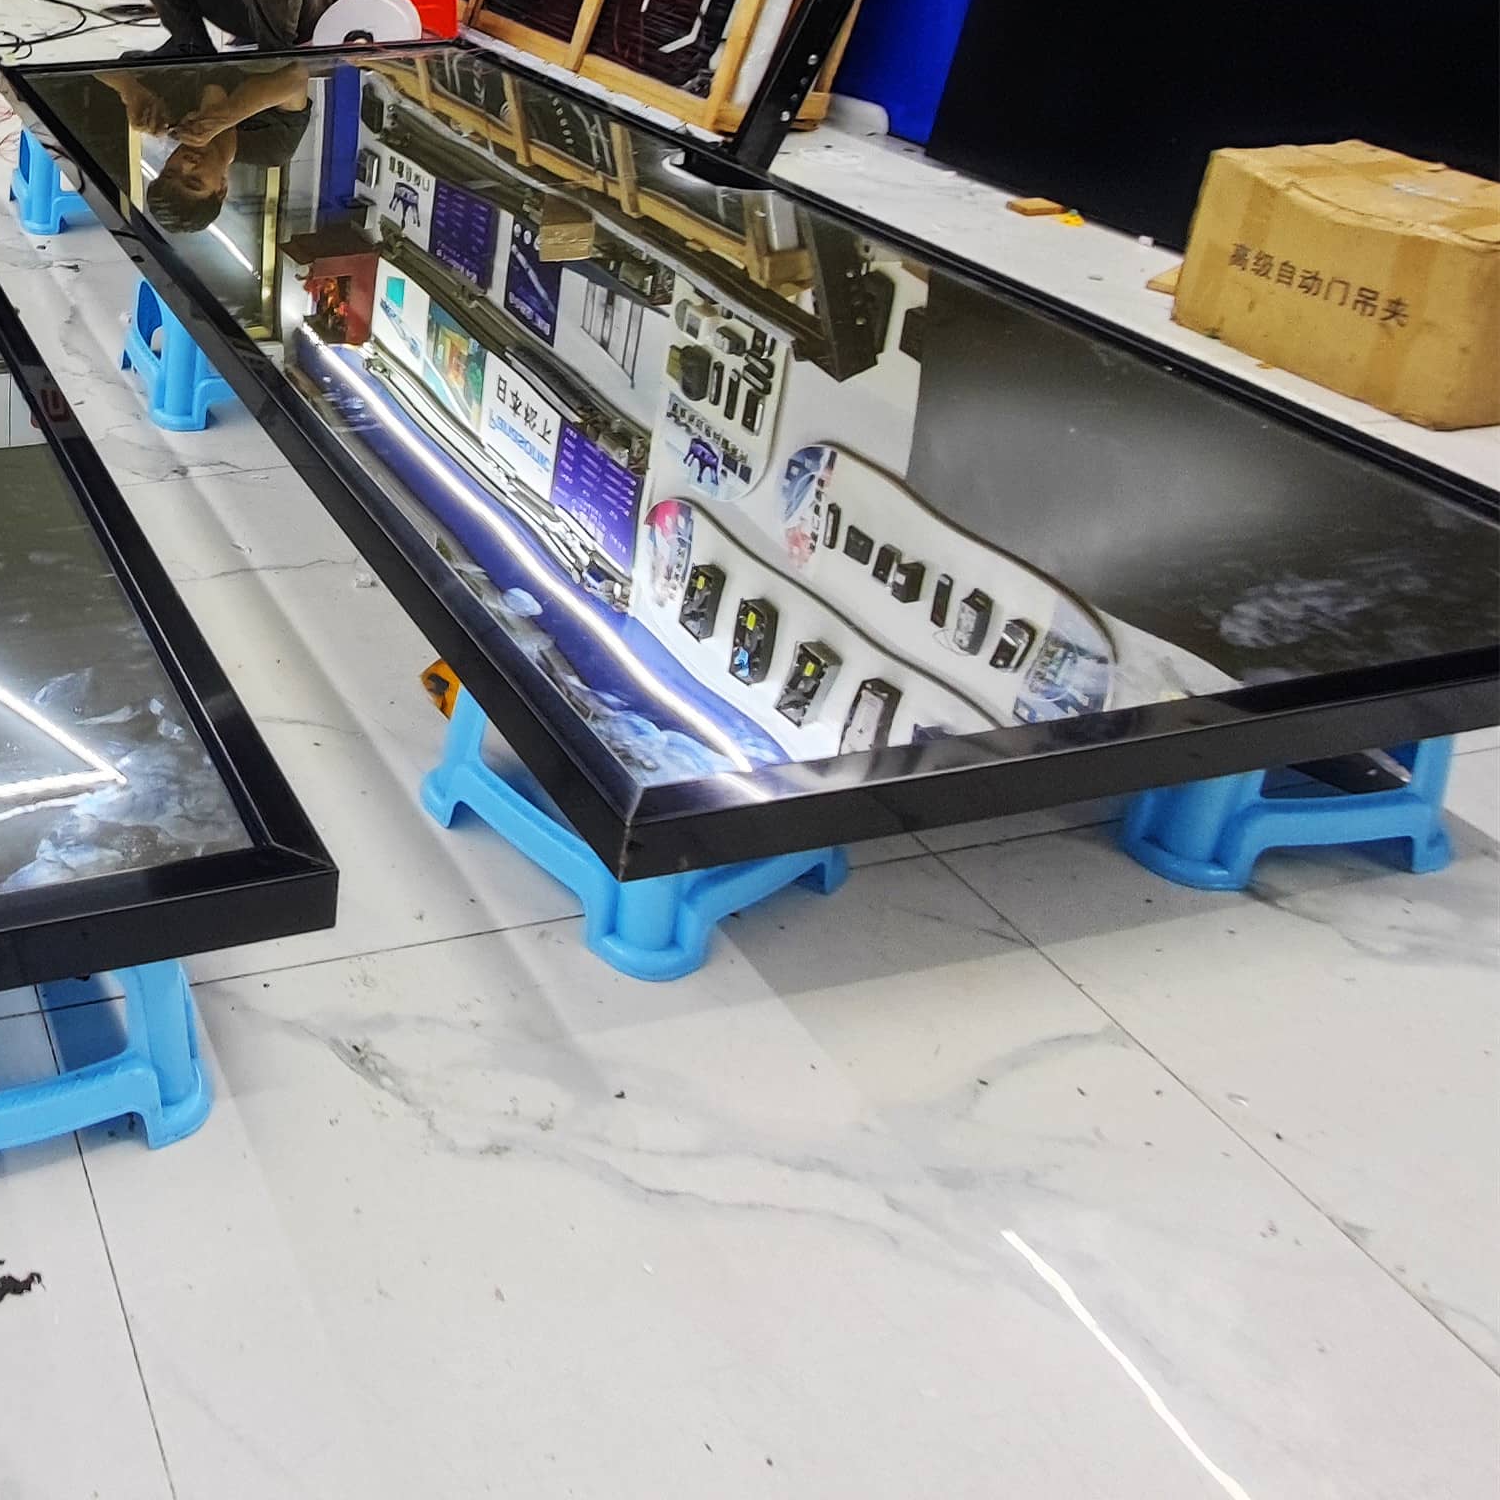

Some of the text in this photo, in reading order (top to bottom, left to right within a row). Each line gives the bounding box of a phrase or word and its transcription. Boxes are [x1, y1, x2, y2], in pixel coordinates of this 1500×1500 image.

[1228, 243, 1411, 329] 高级自动门吊夹
